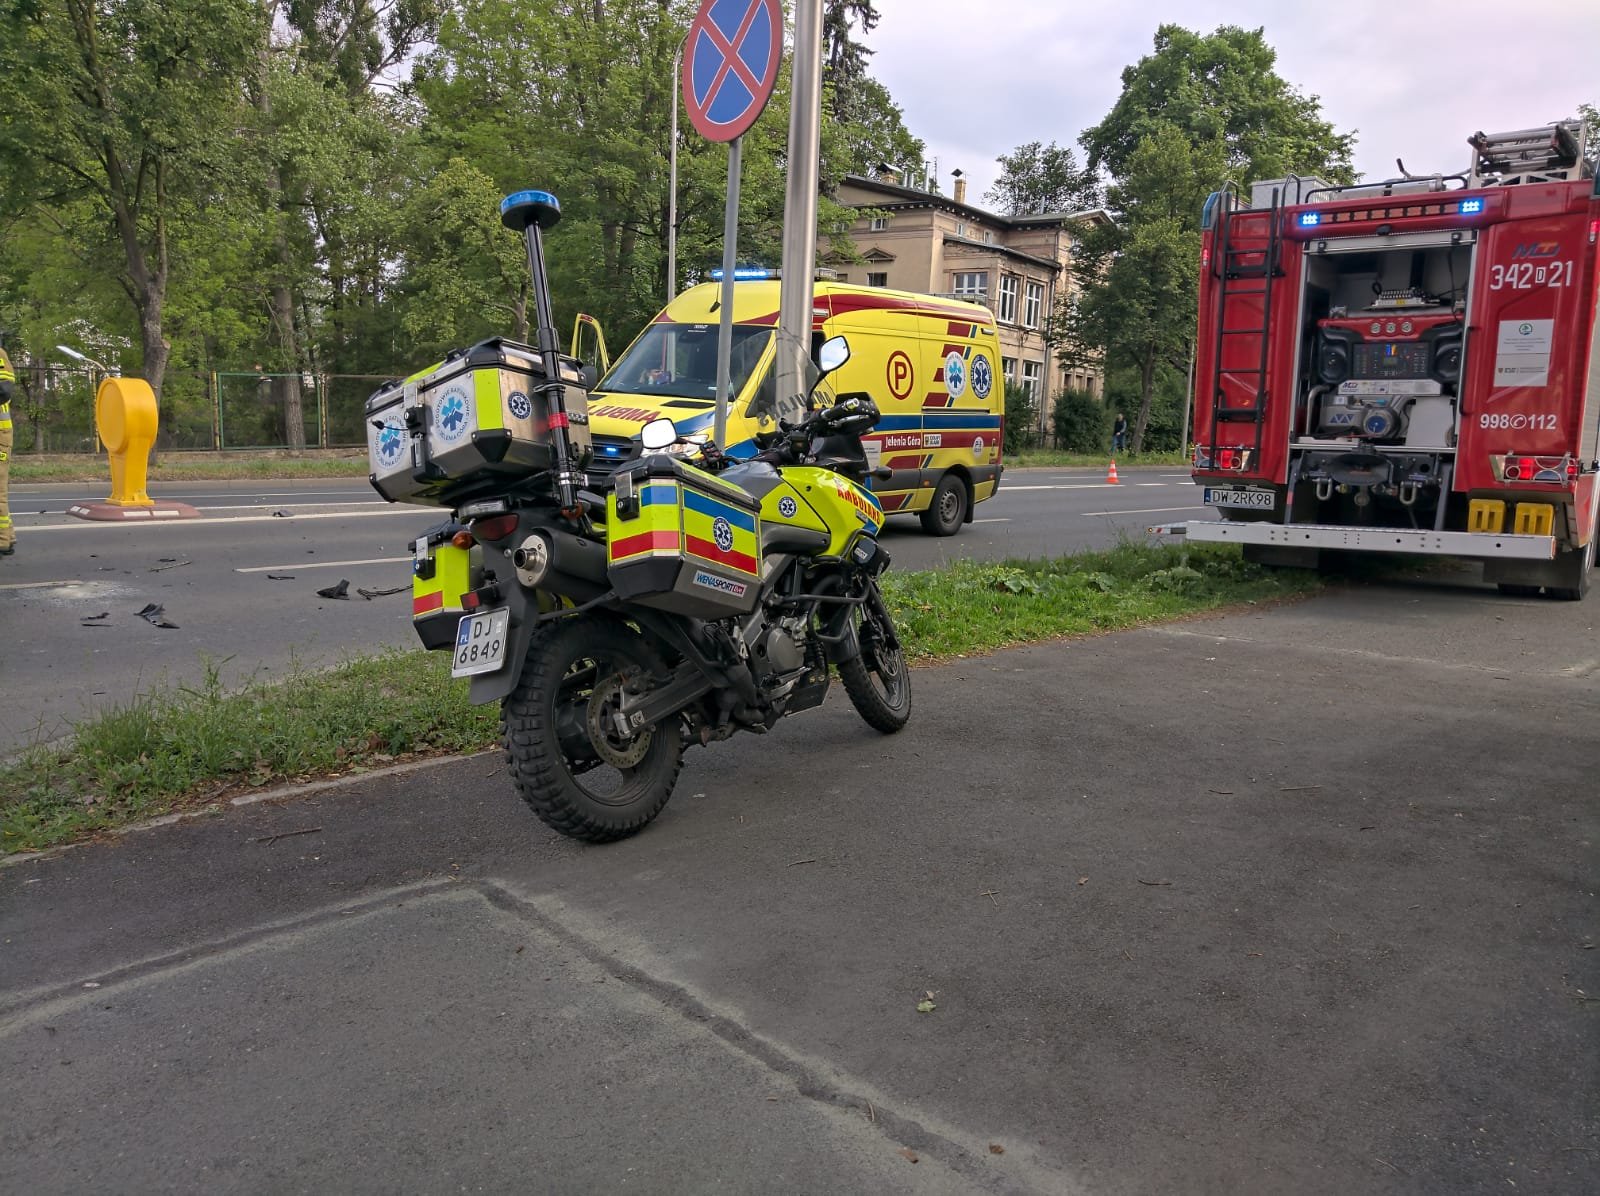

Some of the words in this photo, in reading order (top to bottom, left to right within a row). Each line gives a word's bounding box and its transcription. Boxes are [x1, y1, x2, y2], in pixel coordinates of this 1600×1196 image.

[1490, 263, 1533, 290] 342
[1548, 260, 1573, 288] 21
[894, 361, 907, 390] P
[1479, 413, 1510, 429] 998
[1528, 413, 1557, 429] 112
[885, 435, 906, 449] Jelenia
[907, 435, 921, 446] Góra
[1212, 490, 1229, 503] DW
[1232, 492, 1271, 506] 2RK98
[473, 617, 493, 640] DJ
[459, 639, 500, 664] 6849
